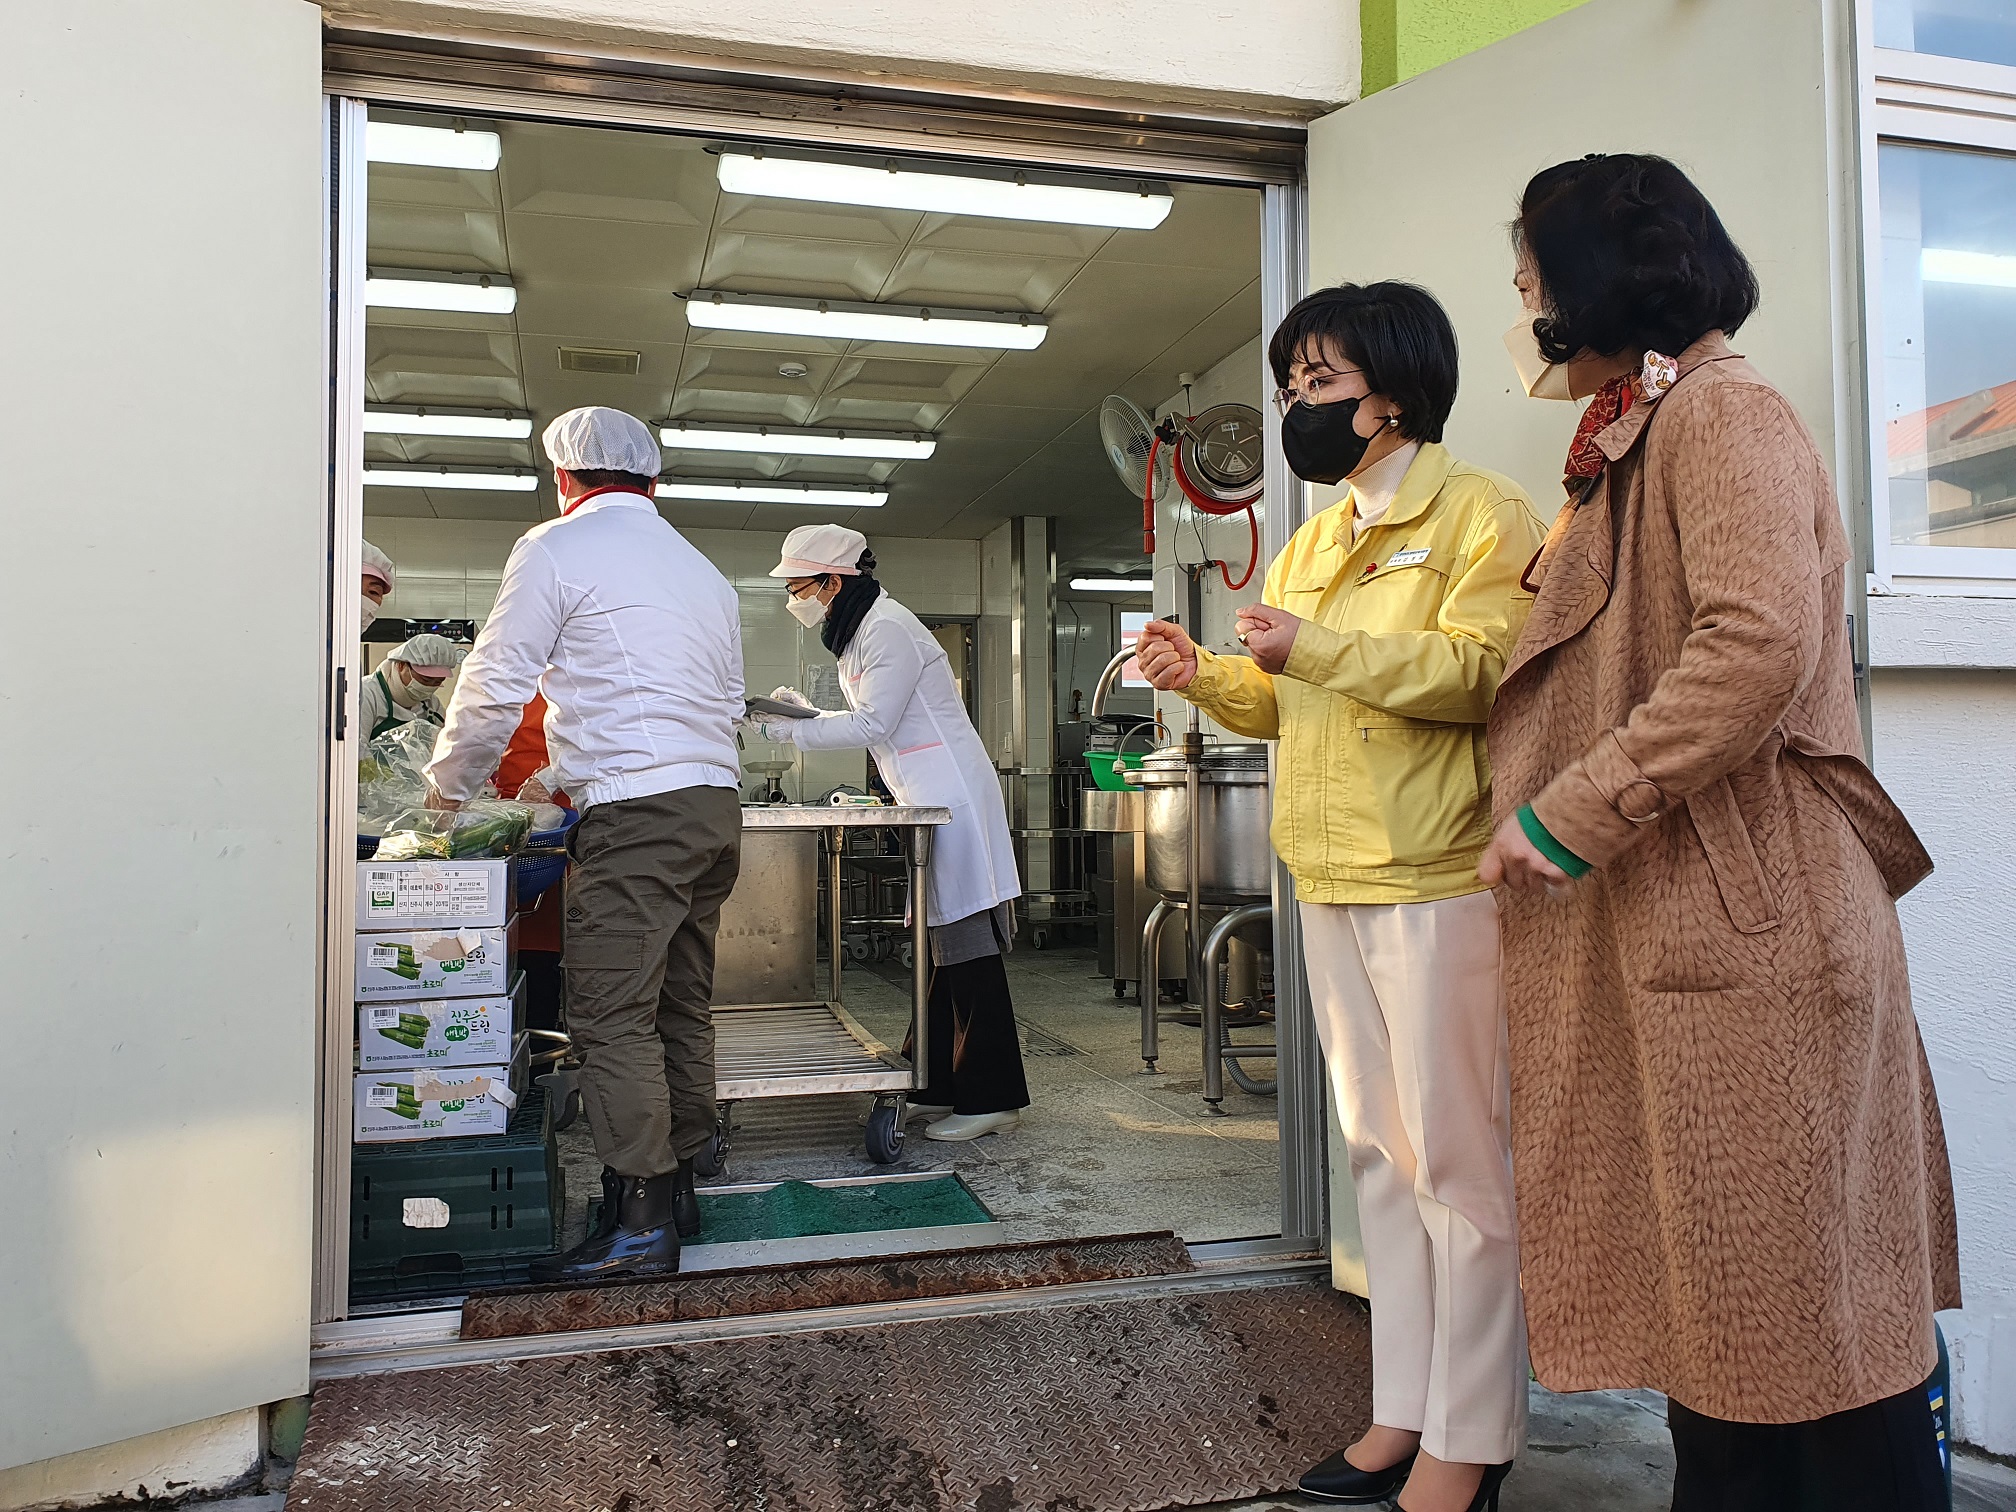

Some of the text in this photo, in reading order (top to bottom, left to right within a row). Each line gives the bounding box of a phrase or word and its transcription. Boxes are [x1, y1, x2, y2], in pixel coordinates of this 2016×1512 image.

[422, 977, 447, 989] 초로미
[451, 1009, 481, 1024] 진주
[445, 1027, 468, 1038] 애호박
[427, 1046, 452, 1058] 초로미
[422, 1116, 447, 1128] 초로미
